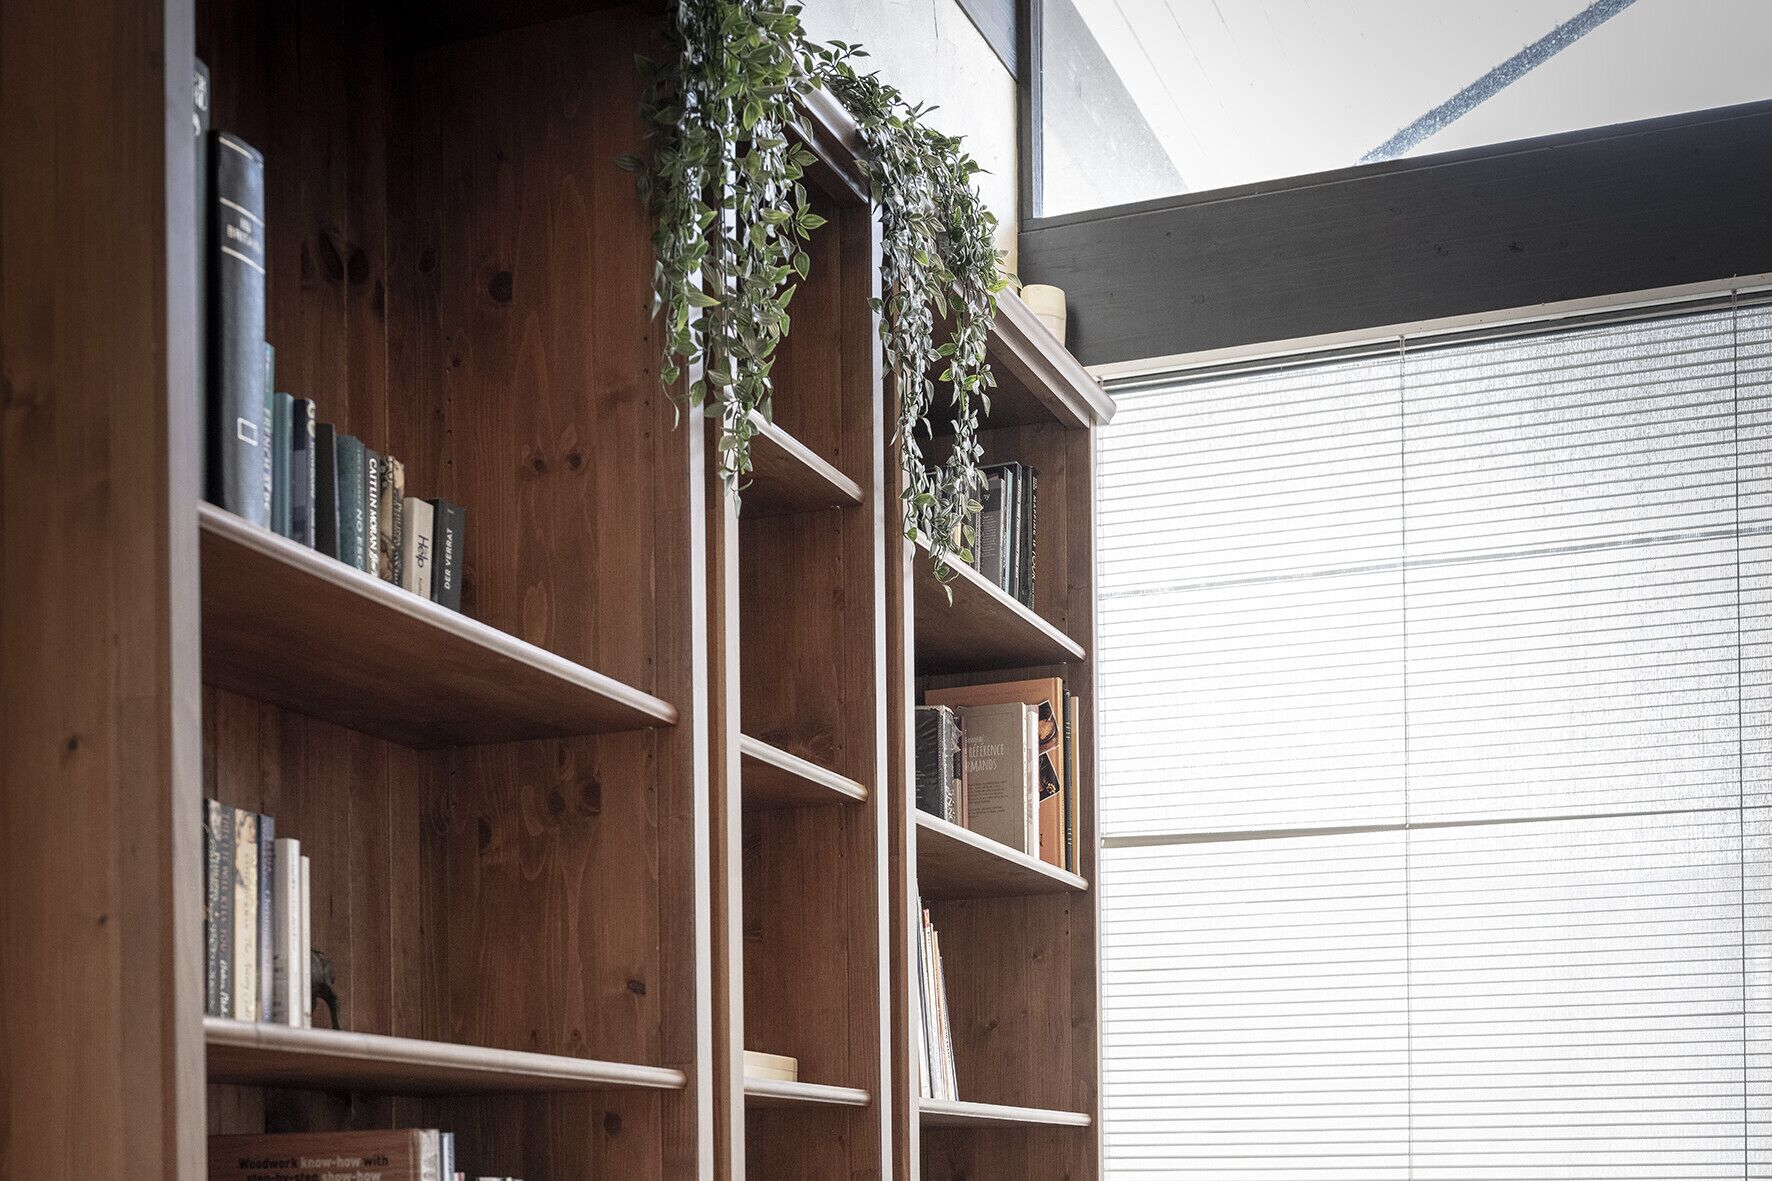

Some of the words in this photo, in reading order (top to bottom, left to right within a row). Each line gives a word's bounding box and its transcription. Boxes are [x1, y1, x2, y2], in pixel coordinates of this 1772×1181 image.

[263, 407, 272, 470] FRENCH
[368, 457, 378, 508] CAITLIN
[356, 508, 363, 532] NO
[369, 508, 377, 549] MORAN
[416, 534, 429, 568] Help
[445, 528, 454, 567] VERRAT
[444, 570, 452, 590] DER
[239, 1157, 298, 1169] Woodwork
[299, 1156, 362, 1168] know-how
[363, 1155, 388, 1166] with
